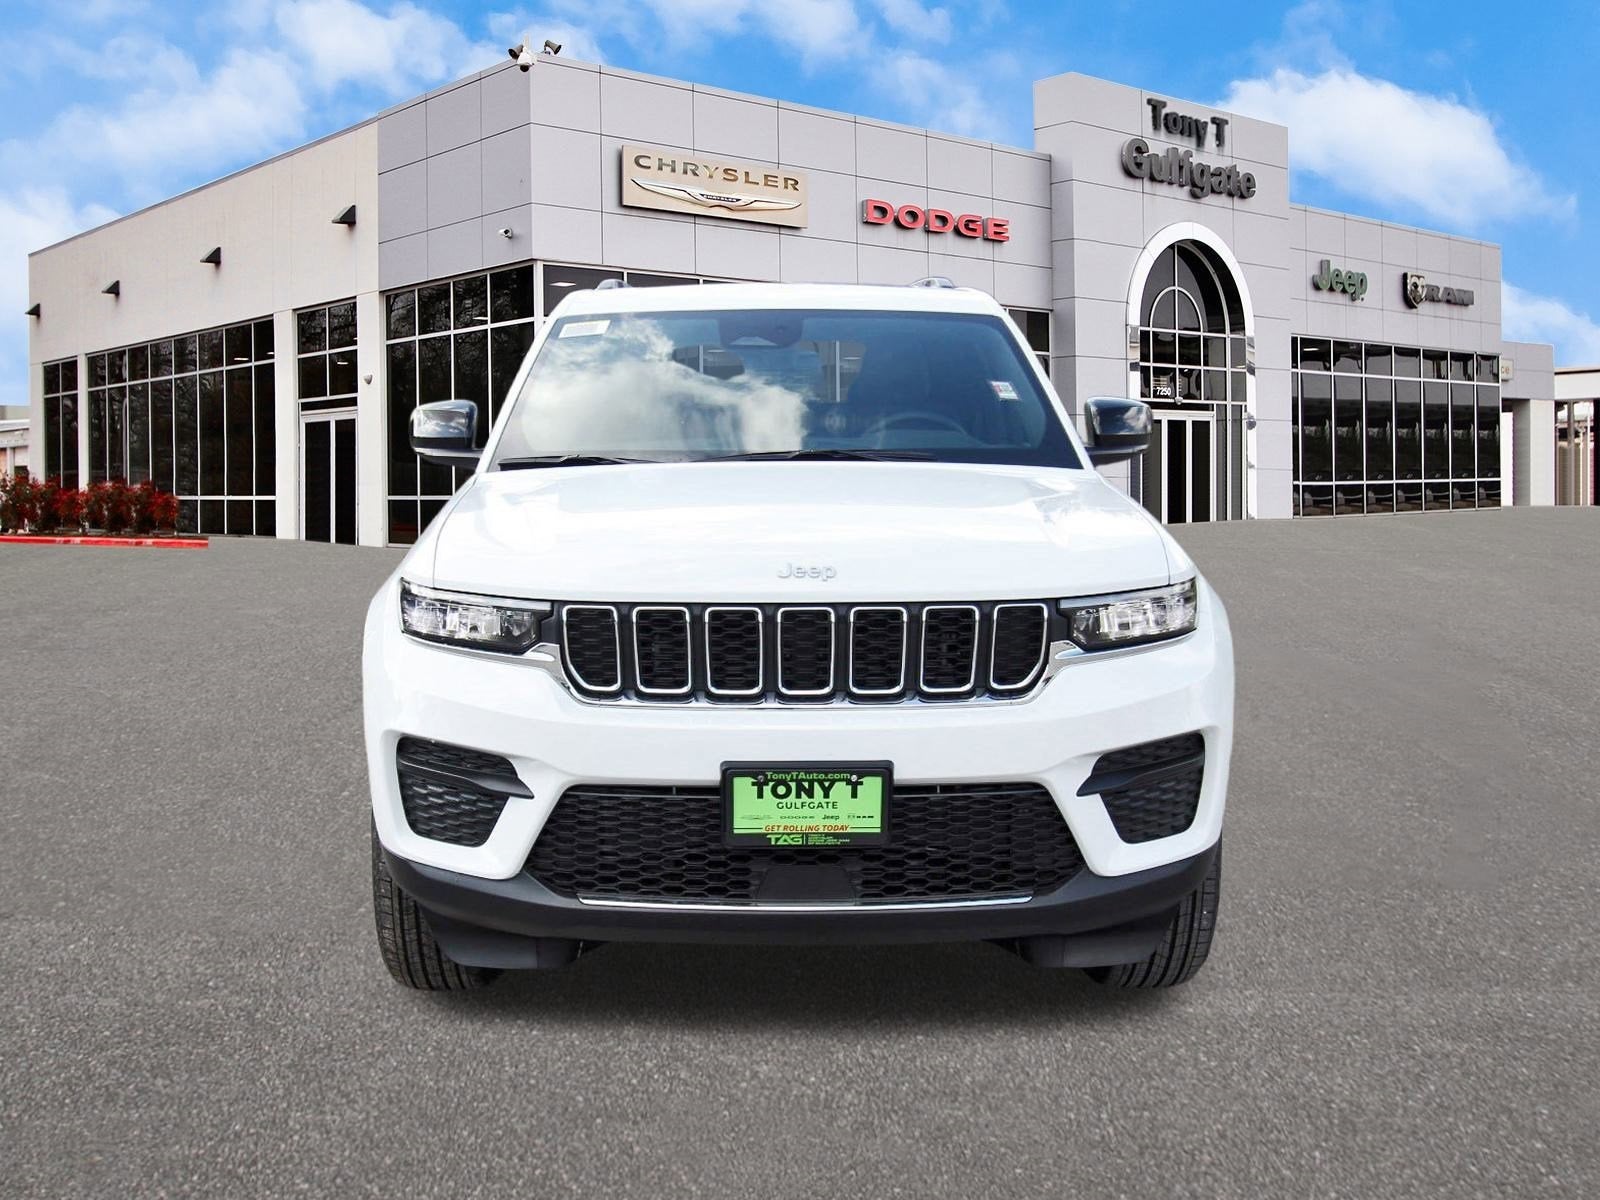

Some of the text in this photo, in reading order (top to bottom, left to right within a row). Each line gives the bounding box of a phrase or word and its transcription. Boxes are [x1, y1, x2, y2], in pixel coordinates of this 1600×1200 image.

[1146, 97, 1229, 147] Tony T
[633, 154, 800, 192] CHRYSLER
[1121, 138, 1256, 199] Gulfgate
[862, 198, 1010, 242] DODGE
[1313, 259, 1368, 302] Jeep
[1425, 284, 1475, 306] RAM
[1156, 387, 1171, 396] 7250
[777, 562, 838, 582] Jeep
[765, 771, 850, 781] TonyTAuto.com
[751, 779, 864, 799] TONY T
[776, 801, 839, 810] GULFGATE
[823, 824, 849, 832] TODAY
[766, 834, 801, 846] TAG
